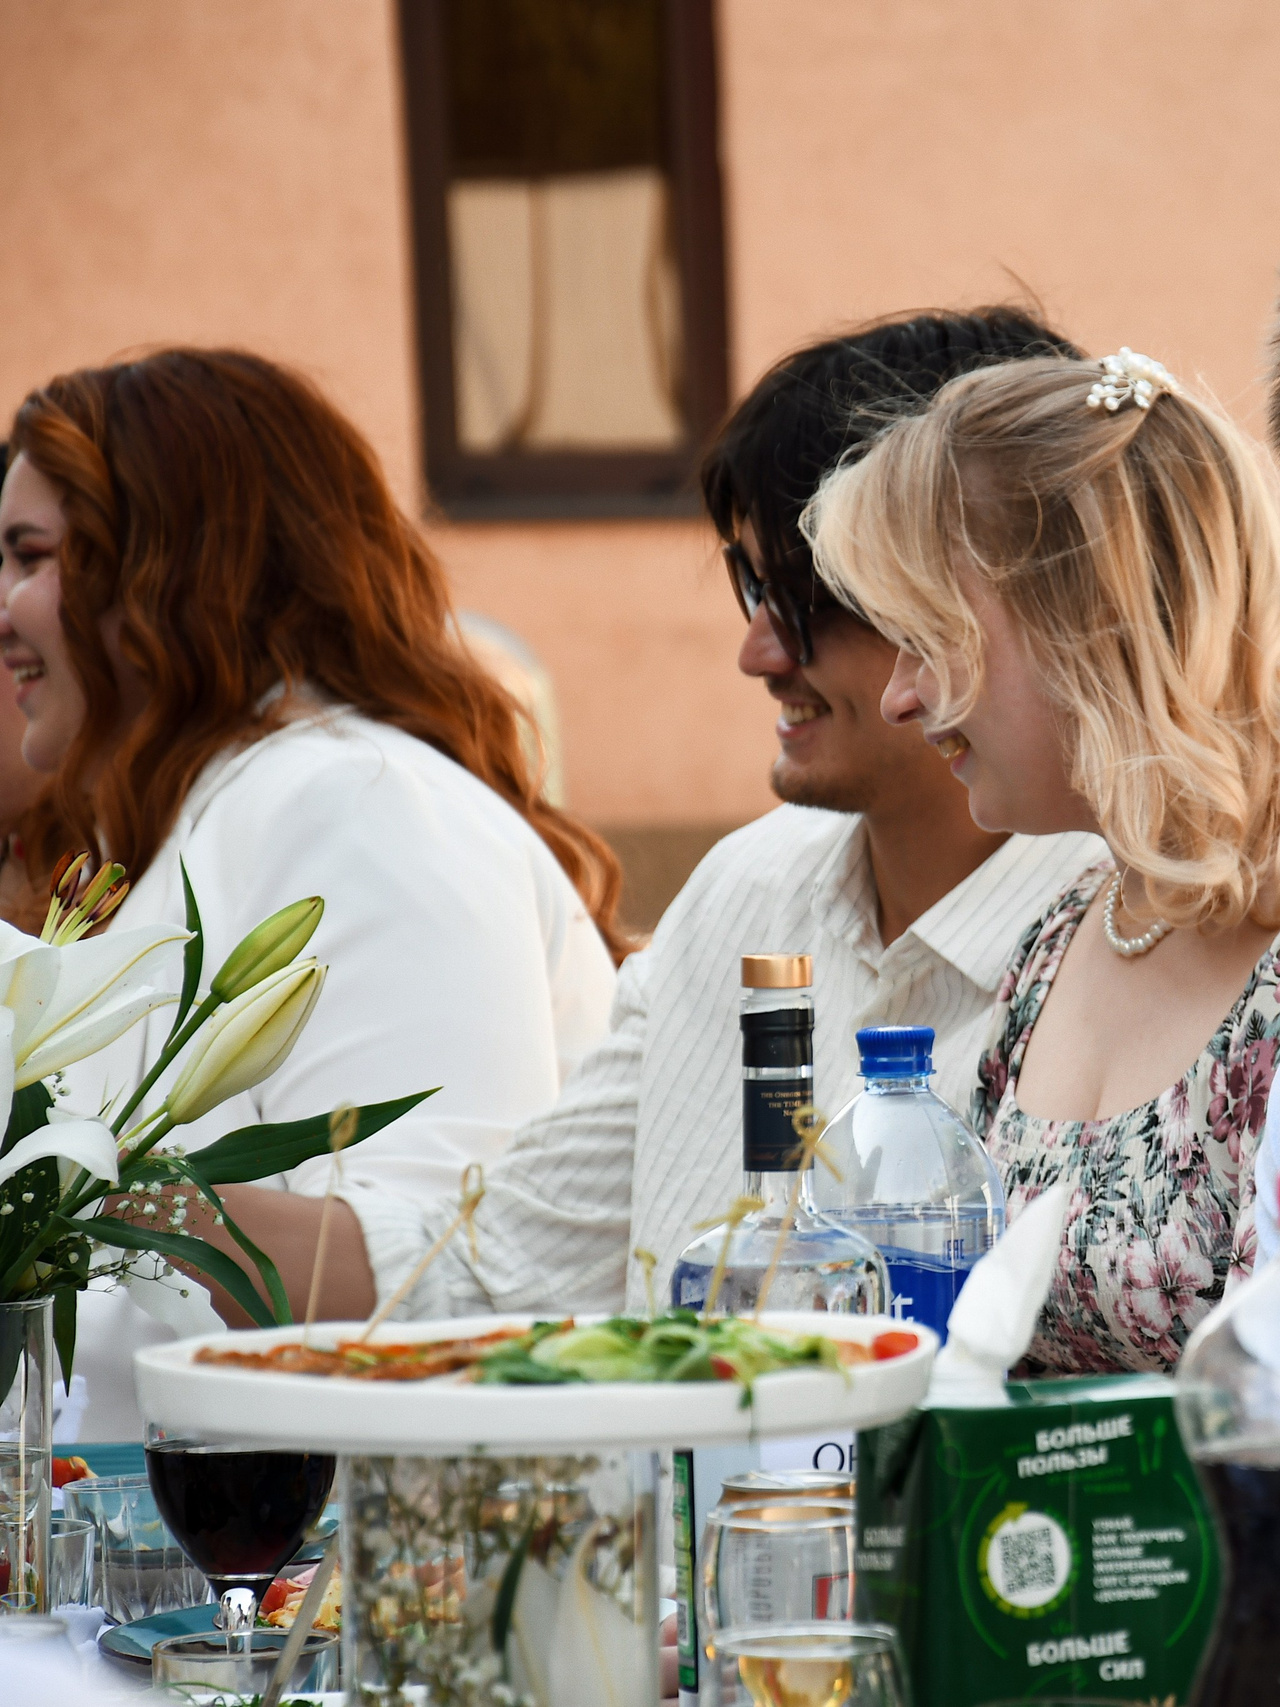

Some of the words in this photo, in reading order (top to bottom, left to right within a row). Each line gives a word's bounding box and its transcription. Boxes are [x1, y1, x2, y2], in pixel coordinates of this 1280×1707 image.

[1035, 1413, 1134, 1453] БОЛЬШЕ
[1017, 1443, 1109, 1479] ПОЛЬЗЫ
[1026, 1629, 1131, 1667] БОЛЬШЕ
[1099, 1656, 1146, 1682] СИЛ
